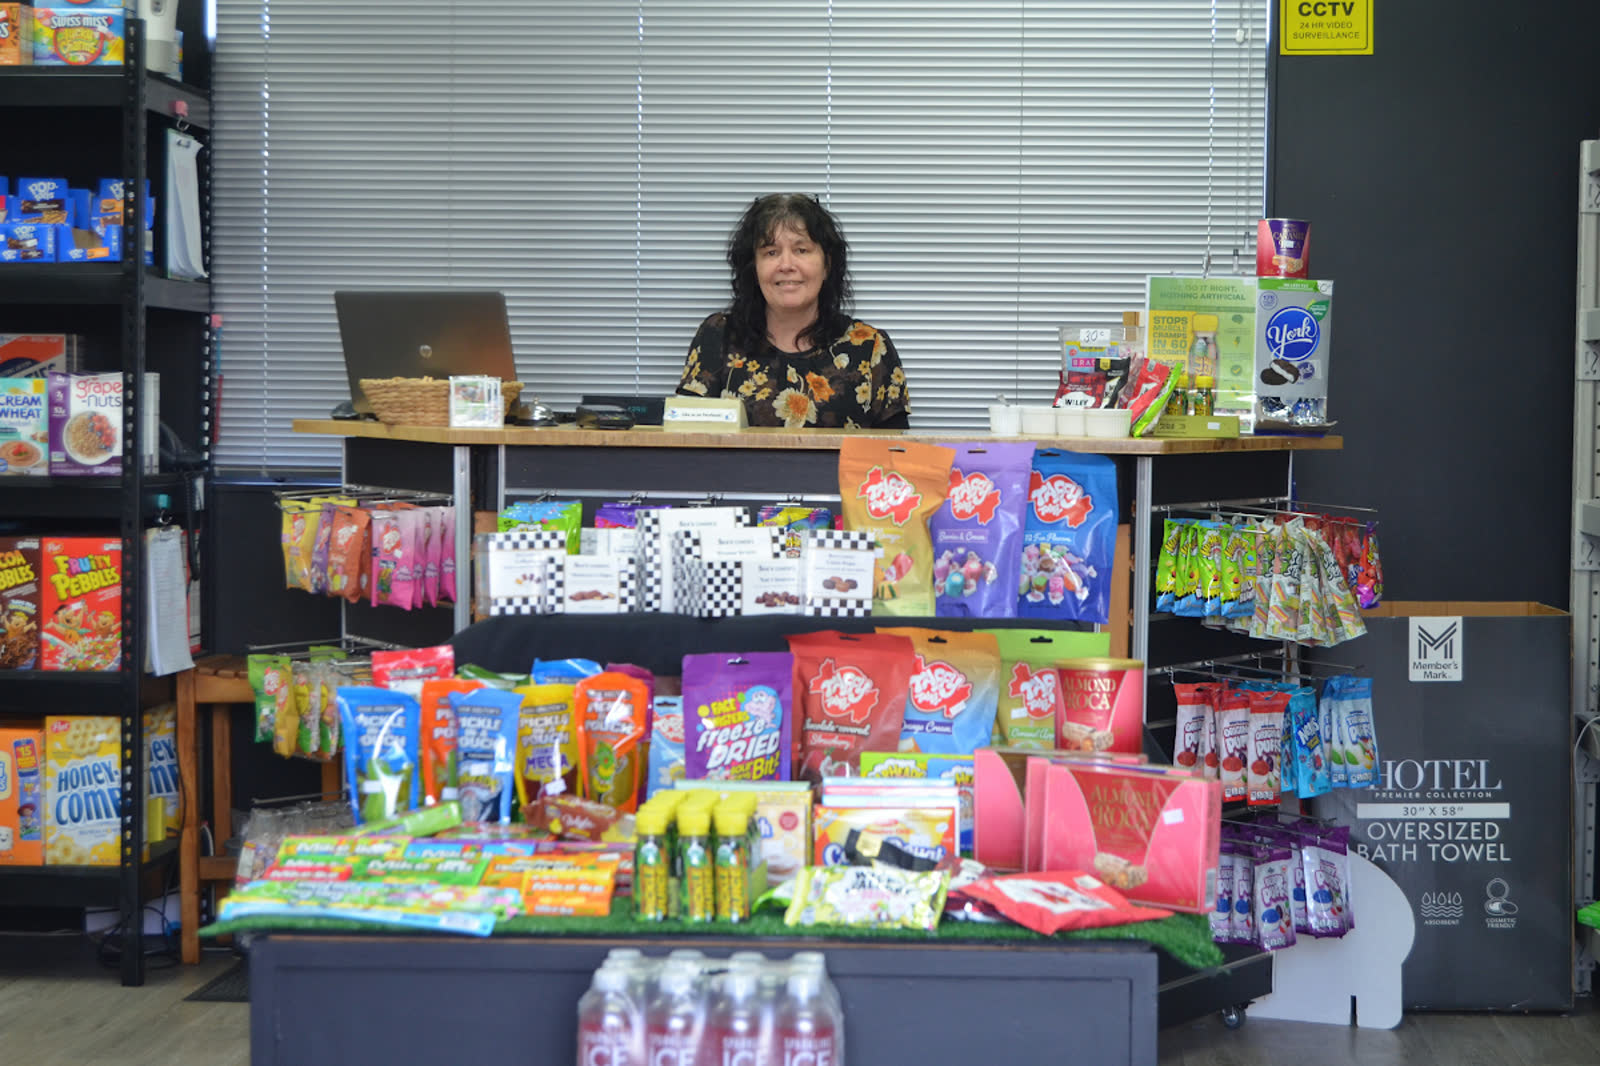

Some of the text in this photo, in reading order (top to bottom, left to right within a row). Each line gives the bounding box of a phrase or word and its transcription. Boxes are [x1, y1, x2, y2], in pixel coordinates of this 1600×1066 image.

[1298, 2, 1354, 16] CCTV
[1327, 21, 1353, 29] VIDEO
[1293, 31, 1360, 39] SURVEILLANCE
[1200, 292, 1246, 300] ARTIFICIAL
[1153, 316, 1188, 325] STOPS
[1153, 339, 1188, 349] IN 60
[1267, 316, 1318, 359] York
[76, 378, 123, 399] grape
[0, 408, 43, 419] WHEAT
[949, 477, 994, 506] TAFFY
[1031, 479, 1084, 509] TAFFY
[54, 554, 112, 575] FRUITY
[50, 567, 121, 601] PEBBLES
[1412, 661, 1459, 670] Member's
[1423, 670, 1447, 680] Mark
[821, 671, 874, 703] TAFFY
[911, 667, 964, 701] TAFFY
[1062, 675, 1117, 693] ALMOND
[1065, 692, 1111, 711] ROCA
[458, 716, 502, 731] ICKLE
[696, 718, 767, 753] freeze
[706, 731, 781, 770] DRIED
[1366, 759, 1502, 790] HOTEL
[1428, 807, 1437, 816] X
[1367, 822, 1500, 841] OVERSIZED
[1357, 844, 1511, 863] BATH TOWEL
